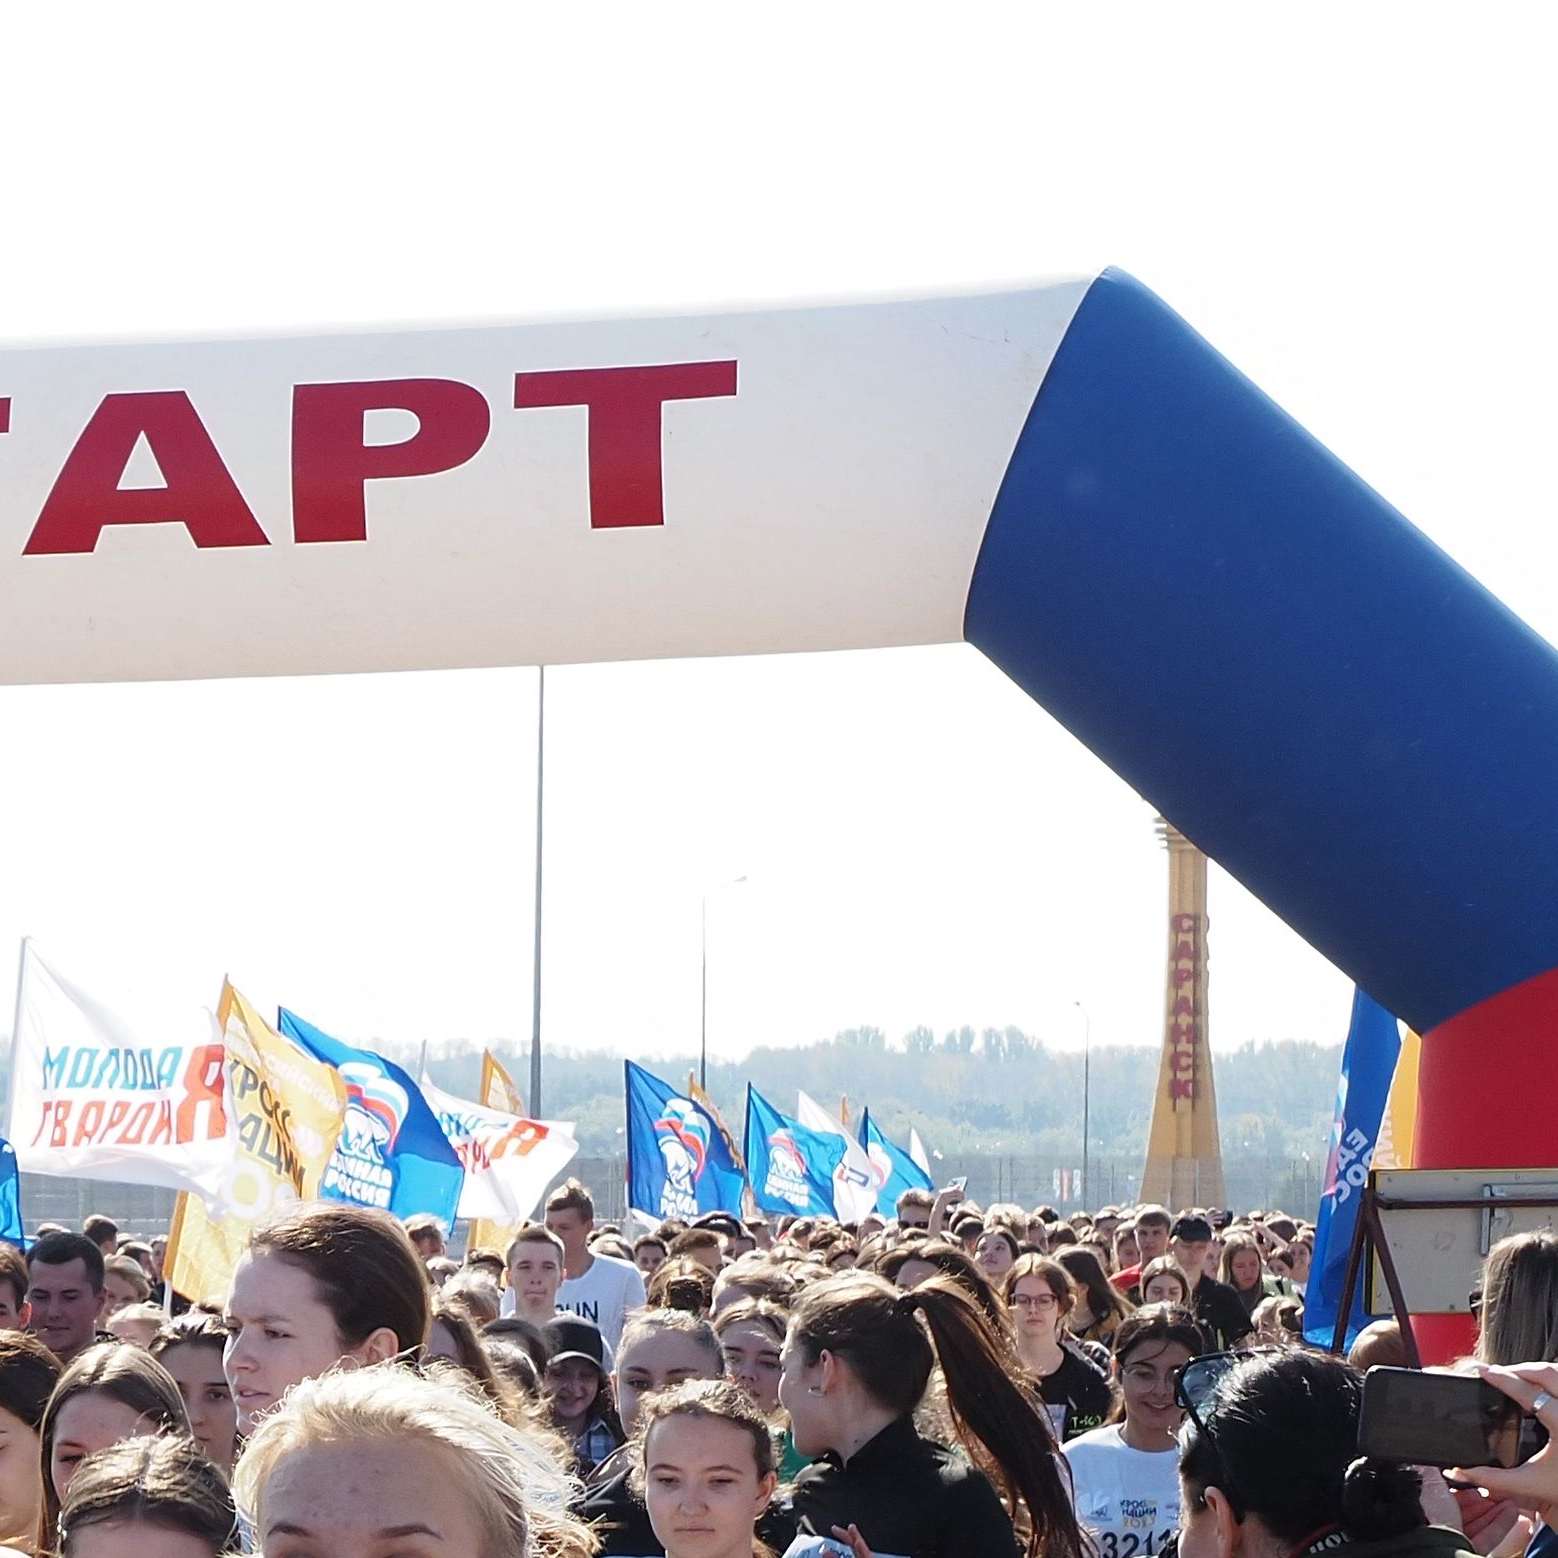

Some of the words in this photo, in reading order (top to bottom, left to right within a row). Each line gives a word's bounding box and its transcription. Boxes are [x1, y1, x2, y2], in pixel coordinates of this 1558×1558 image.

[1168, 913, 1201, 1099] САРАНСК
[229, 1058, 291, 1143] РОСС
[238, 1113, 306, 1198] АЦИИ
